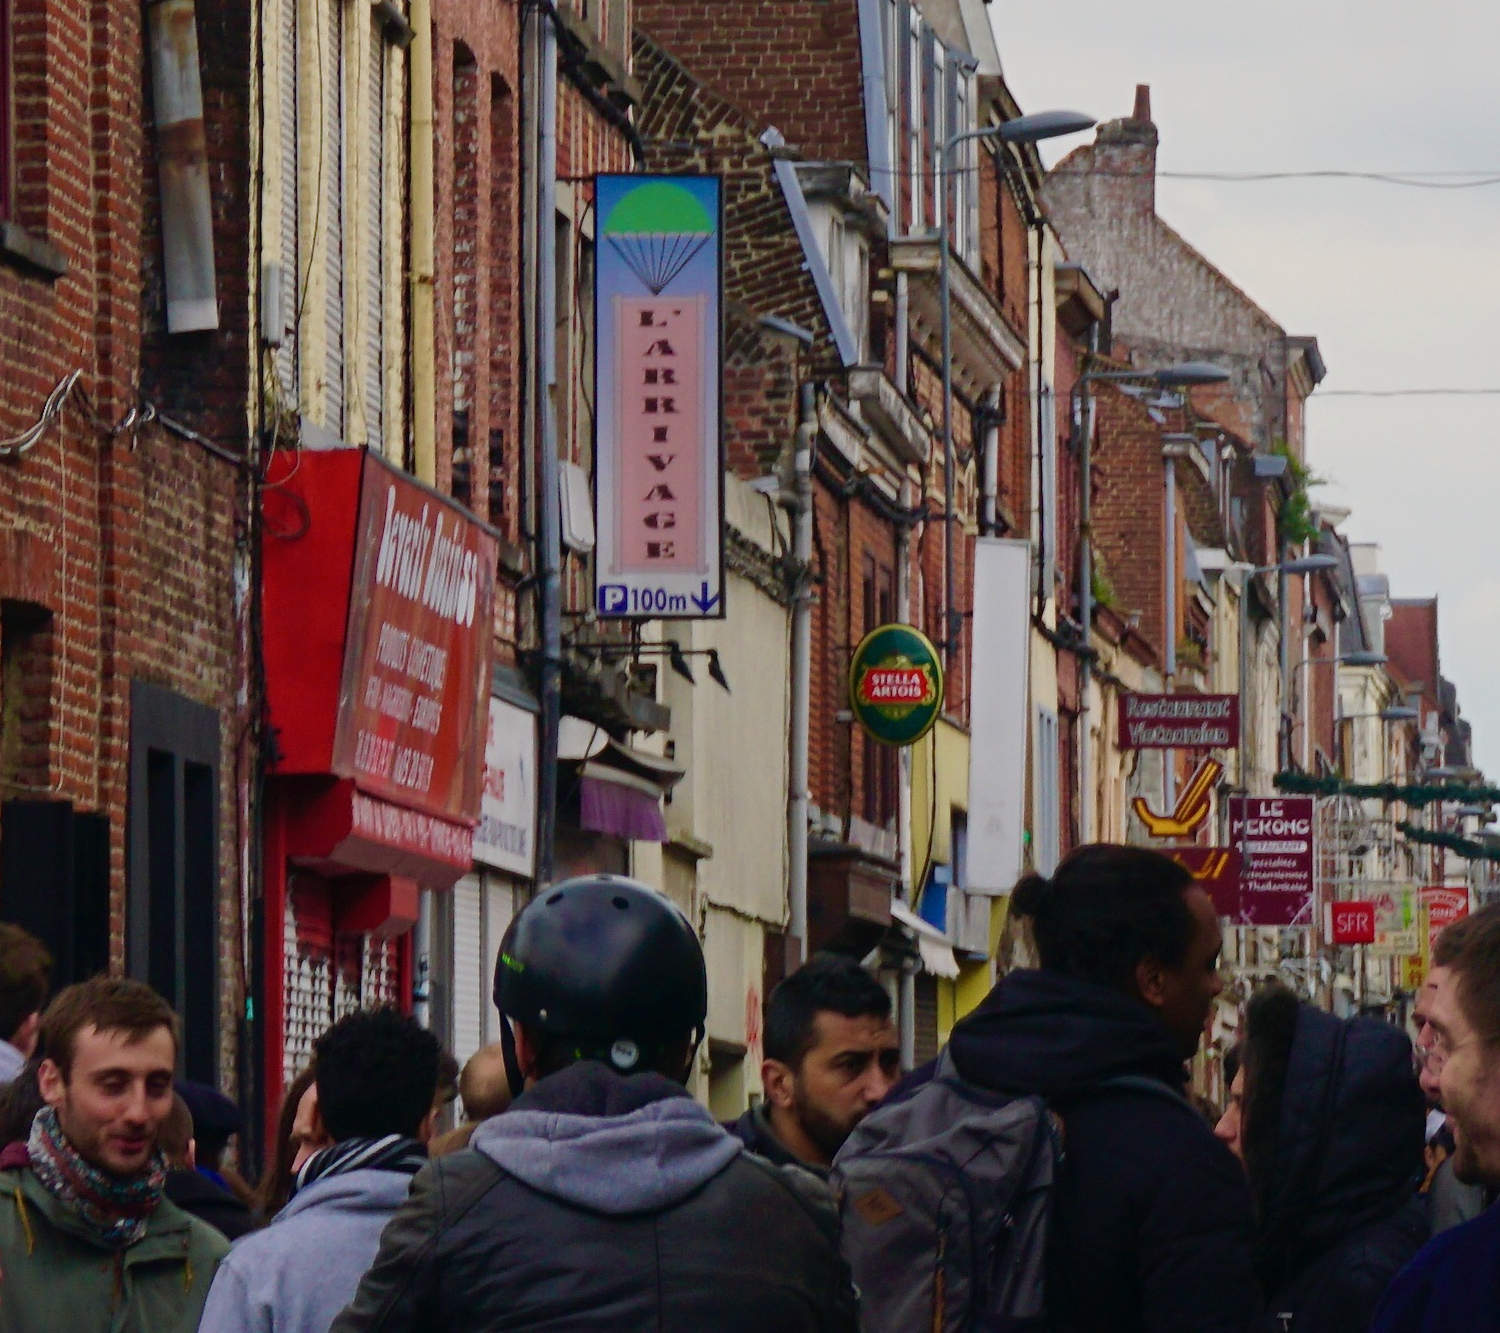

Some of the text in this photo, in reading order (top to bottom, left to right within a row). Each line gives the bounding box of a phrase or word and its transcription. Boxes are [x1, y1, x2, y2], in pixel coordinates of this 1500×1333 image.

[639, 309, 682, 559] L'ARRIVAGE
[631, 587, 687, 612] 100m
[871, 673, 921, 685] STELLA
[871, 685, 922, 698] ARTOIS
[1259, 800, 1284, 818] LE
[1336, 912, 1369, 934] SFR
